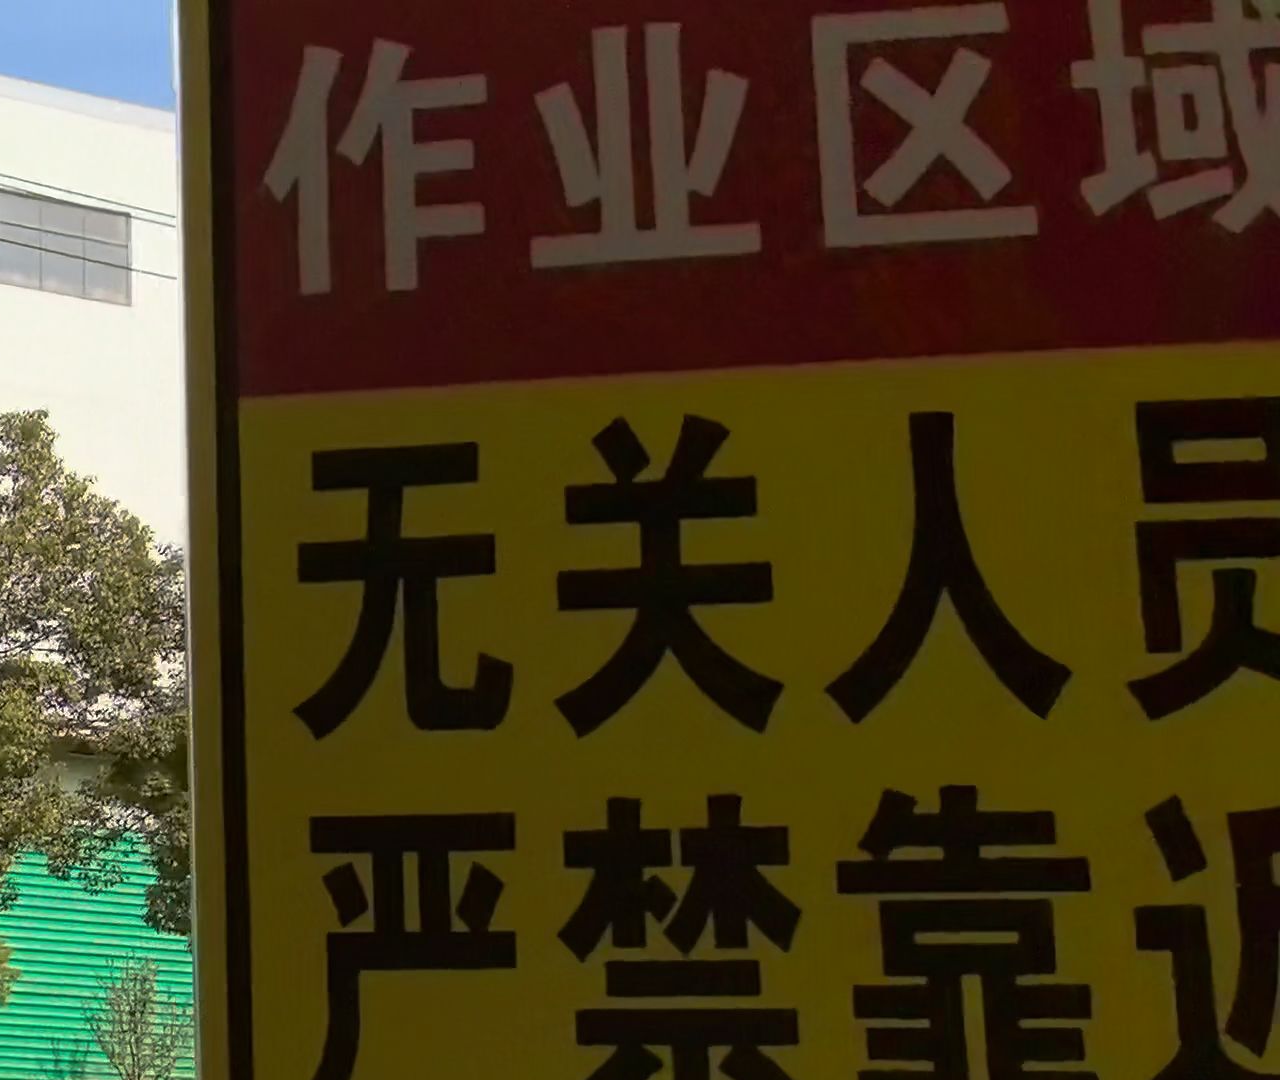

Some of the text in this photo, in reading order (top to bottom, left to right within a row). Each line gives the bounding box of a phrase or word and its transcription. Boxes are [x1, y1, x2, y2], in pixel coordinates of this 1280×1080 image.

[263, 0, 1280, 295] 作业区域
[292, 398, 1280, 741] 无关人员
